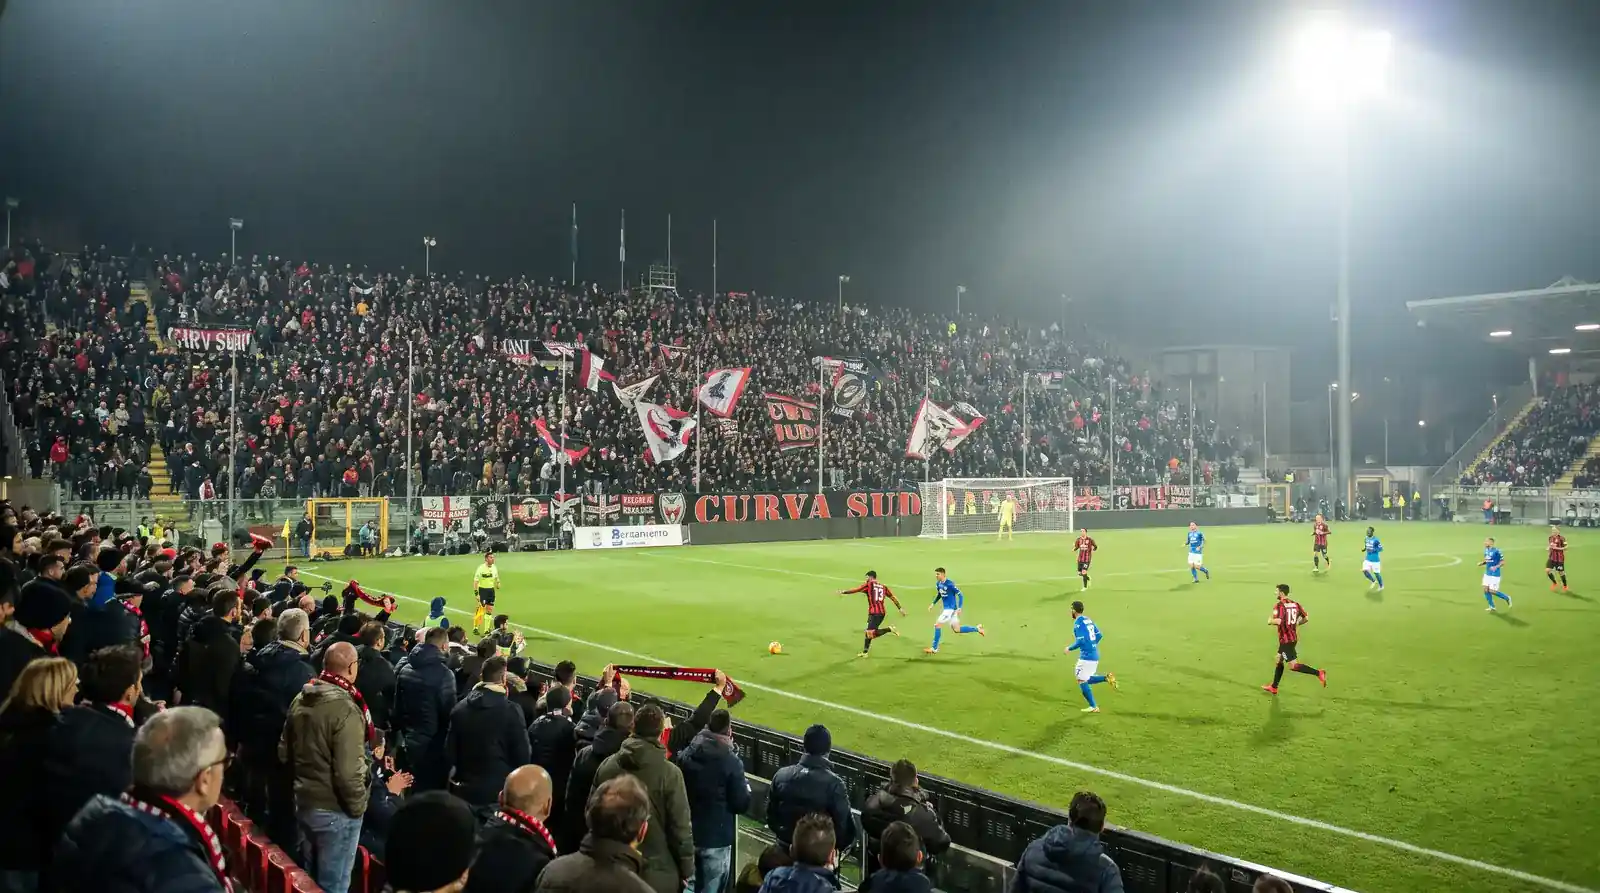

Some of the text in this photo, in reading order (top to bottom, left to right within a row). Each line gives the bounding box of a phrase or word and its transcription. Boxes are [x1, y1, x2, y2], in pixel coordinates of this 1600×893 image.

[694, 492, 831, 523] CURVA
[847, 491, 922, 518] SUD
[873, 587, 884, 601] 13
